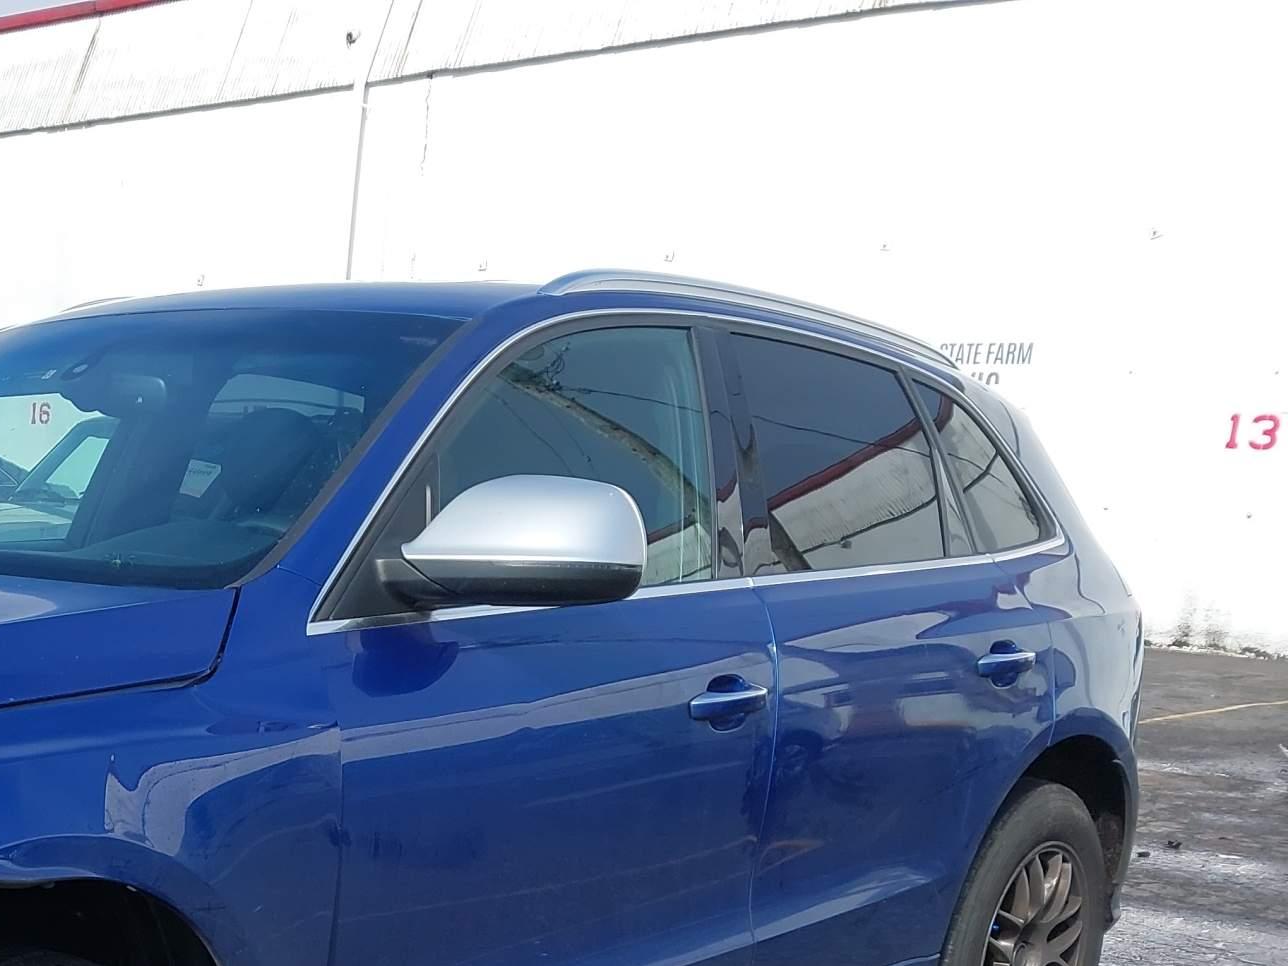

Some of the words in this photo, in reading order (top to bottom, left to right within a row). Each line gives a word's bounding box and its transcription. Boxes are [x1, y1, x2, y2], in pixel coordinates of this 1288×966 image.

[986, 342, 1034, 364] FARM
[31, 402, 51, 424] 16
[1225, 413, 1281, 451] 13
